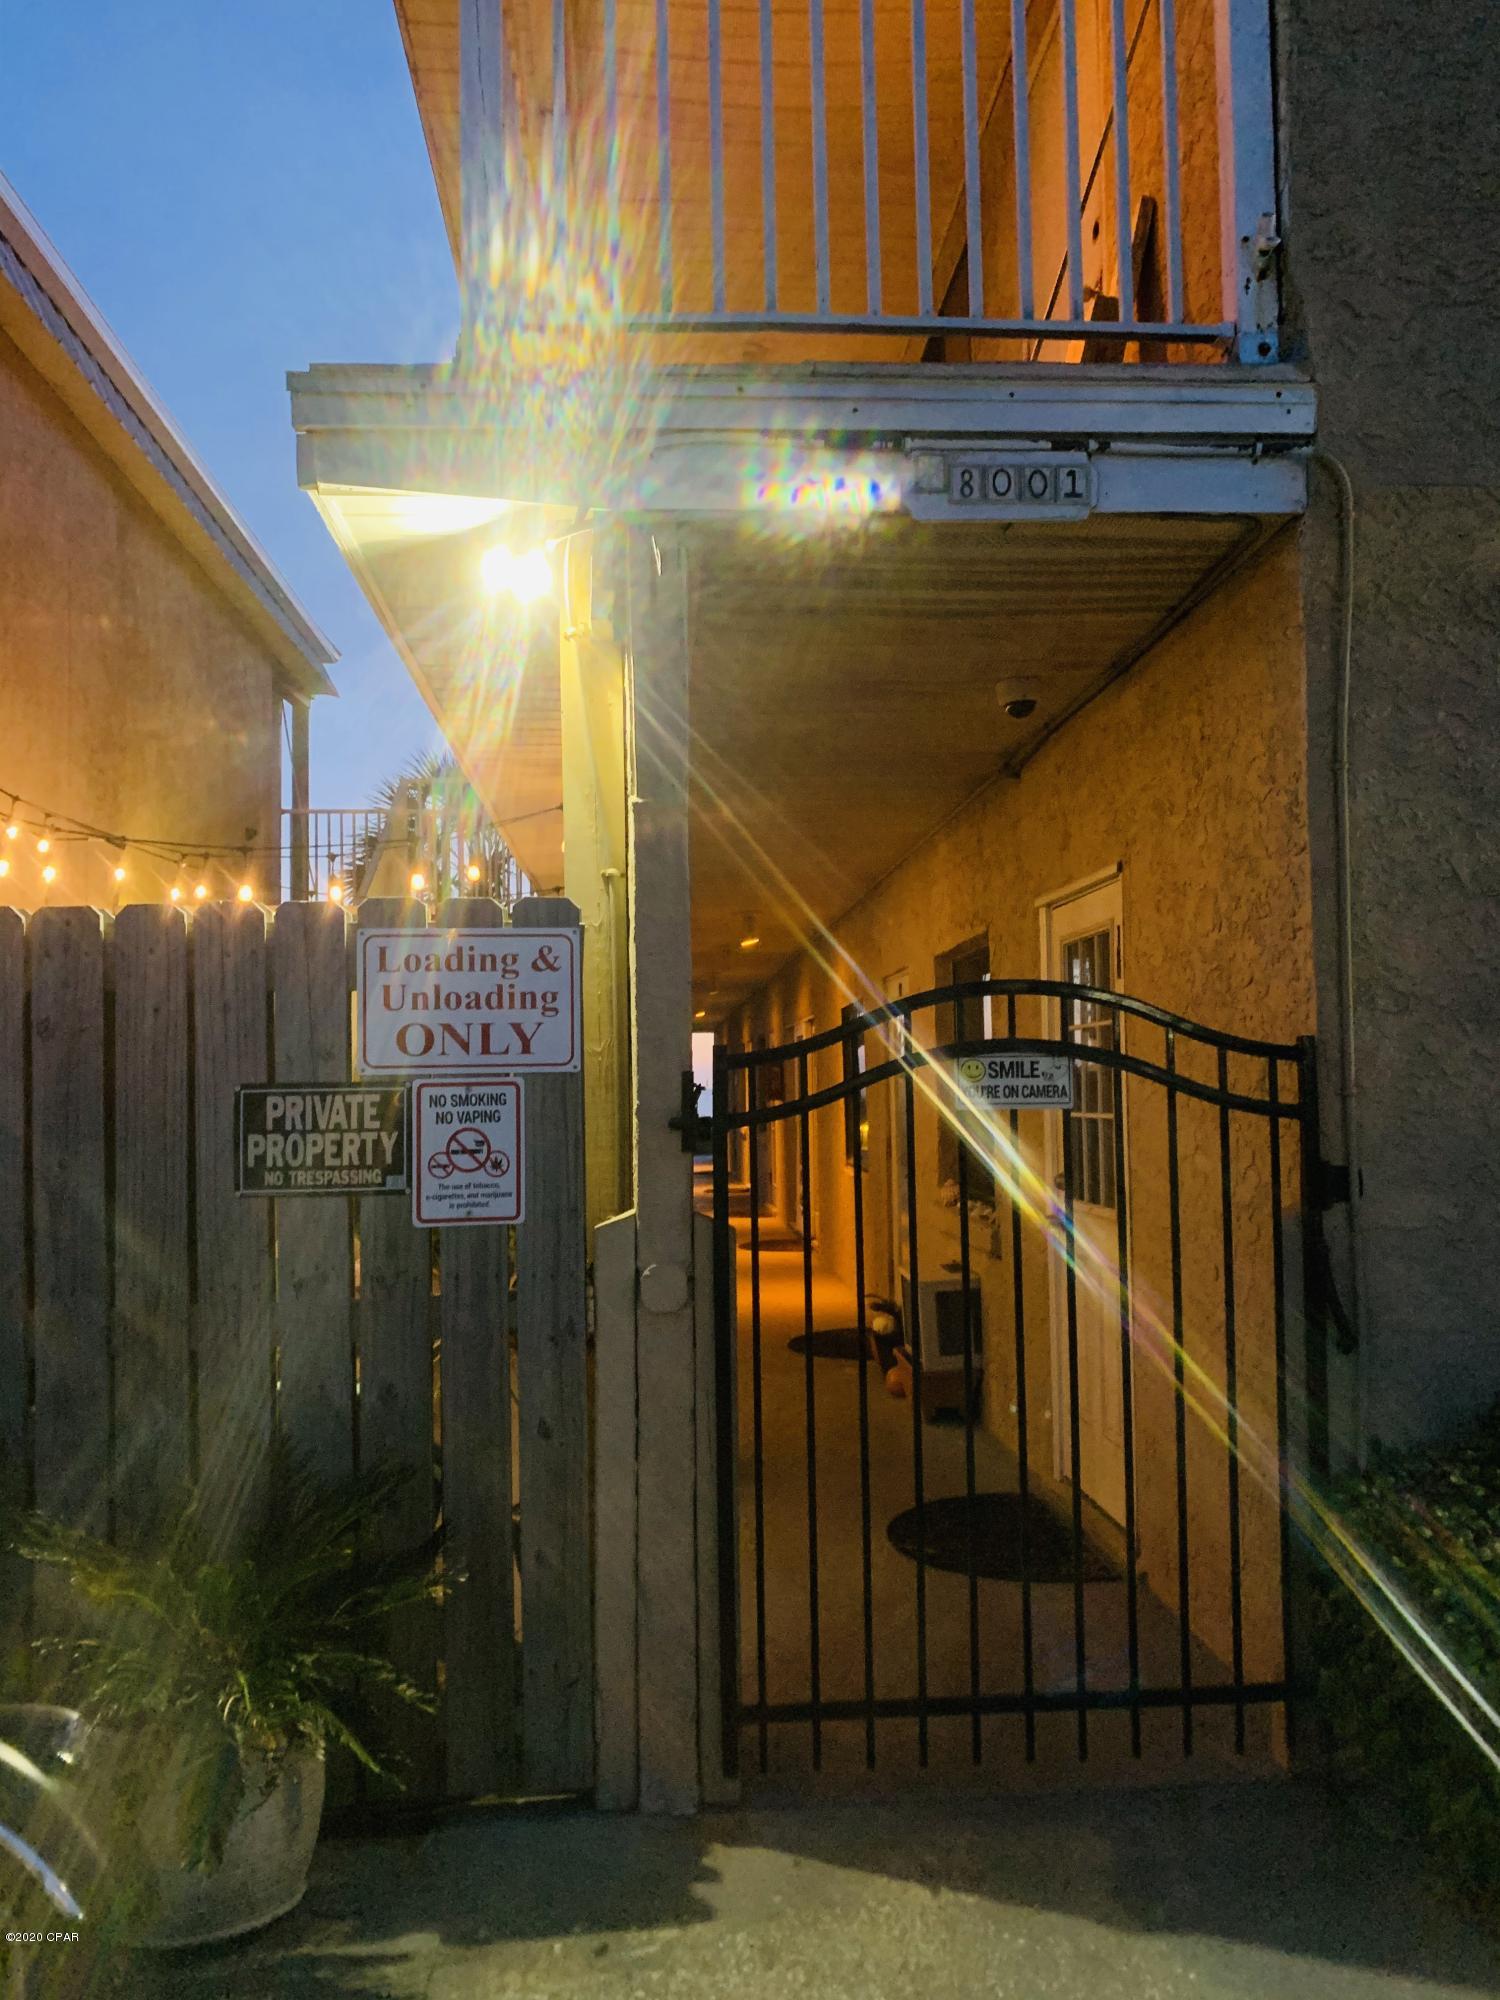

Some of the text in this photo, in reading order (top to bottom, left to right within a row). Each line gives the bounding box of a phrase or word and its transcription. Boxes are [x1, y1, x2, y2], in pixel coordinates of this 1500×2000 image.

[960, 468, 1083, 499] 8001
[377, 944, 562, 980] Loading &
[382, 983, 560, 1018] Unloading
[396, 1022, 544, 1057] ONLY
[988, 1060, 1041, 1079] SMILE
[429, 1092, 507, 1109] NO SMOKING
[964, 1083, 1068, 1099] U'RE ON CAMERA
[265, 1094, 381, 1131] PRIVATE
[435, 1109, 501, 1126] NO VAPING
[247, 1130, 399, 1168] PROPERTY
[264, 1168, 382, 1187] NO TRESPASSING
